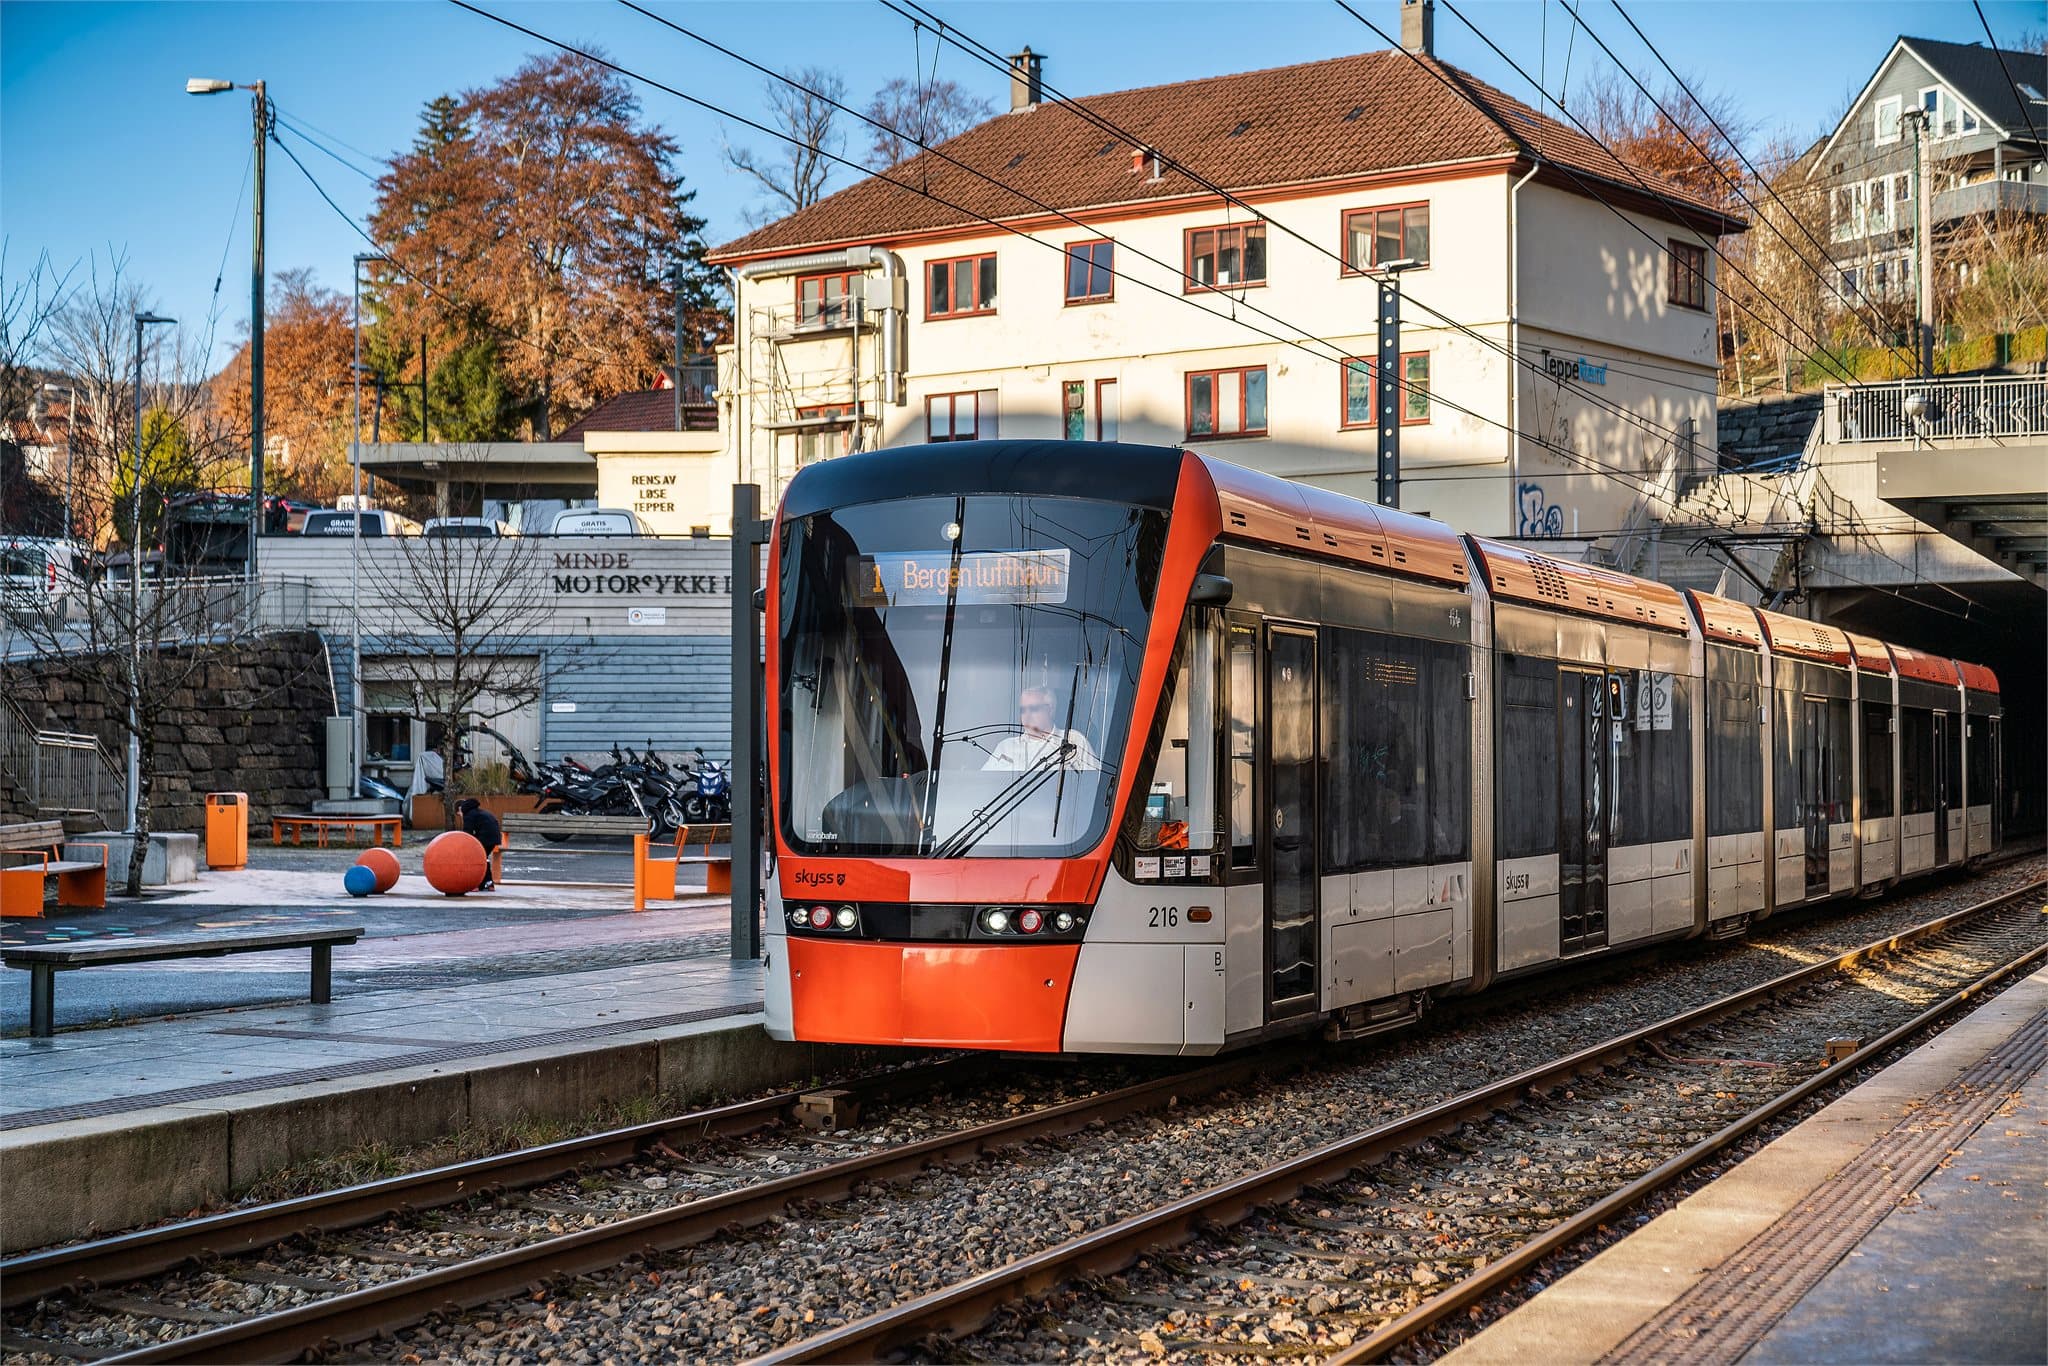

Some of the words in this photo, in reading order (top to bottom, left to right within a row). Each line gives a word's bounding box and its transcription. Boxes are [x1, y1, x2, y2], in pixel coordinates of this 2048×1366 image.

[632, 475, 662, 485] RENS
[664, 475, 677, 485] AV
[639, 489, 667, 499] LØSE
[633, 502, 675, 512] TEPPER
[554, 552, 630, 569] MINDE
[872, 564, 884, 593] 1
[903, 560, 972, 595] Bergen
[975, 557, 1060, 588] lufthavn
[795, 868, 834, 887] skyss
[1506, 870, 1525, 894] skyss
[1148, 906, 1178, 928] 216
[1214, 951, 1222, 967] B
